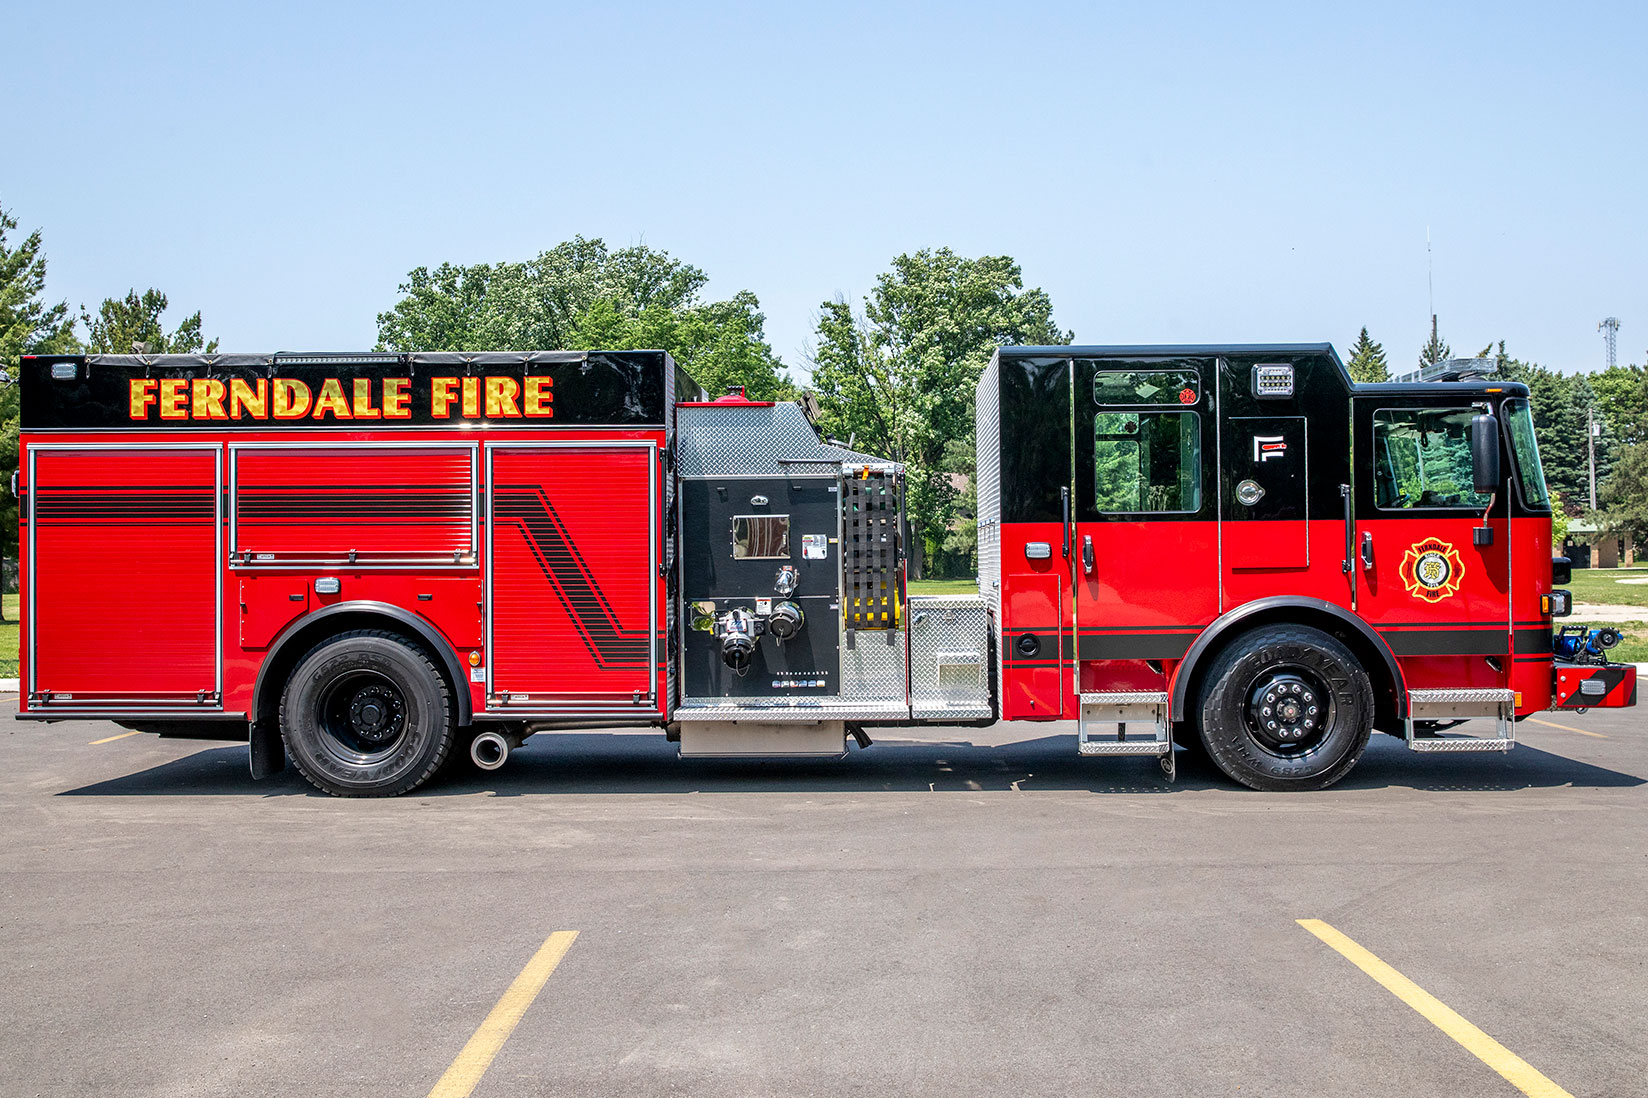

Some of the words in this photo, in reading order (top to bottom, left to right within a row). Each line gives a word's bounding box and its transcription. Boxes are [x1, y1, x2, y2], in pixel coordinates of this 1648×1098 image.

[129, 378, 413, 420] FERNDALE
[430, 376, 554, 419] FIRE
[1418, 544, 1446, 553] FERNDALE
